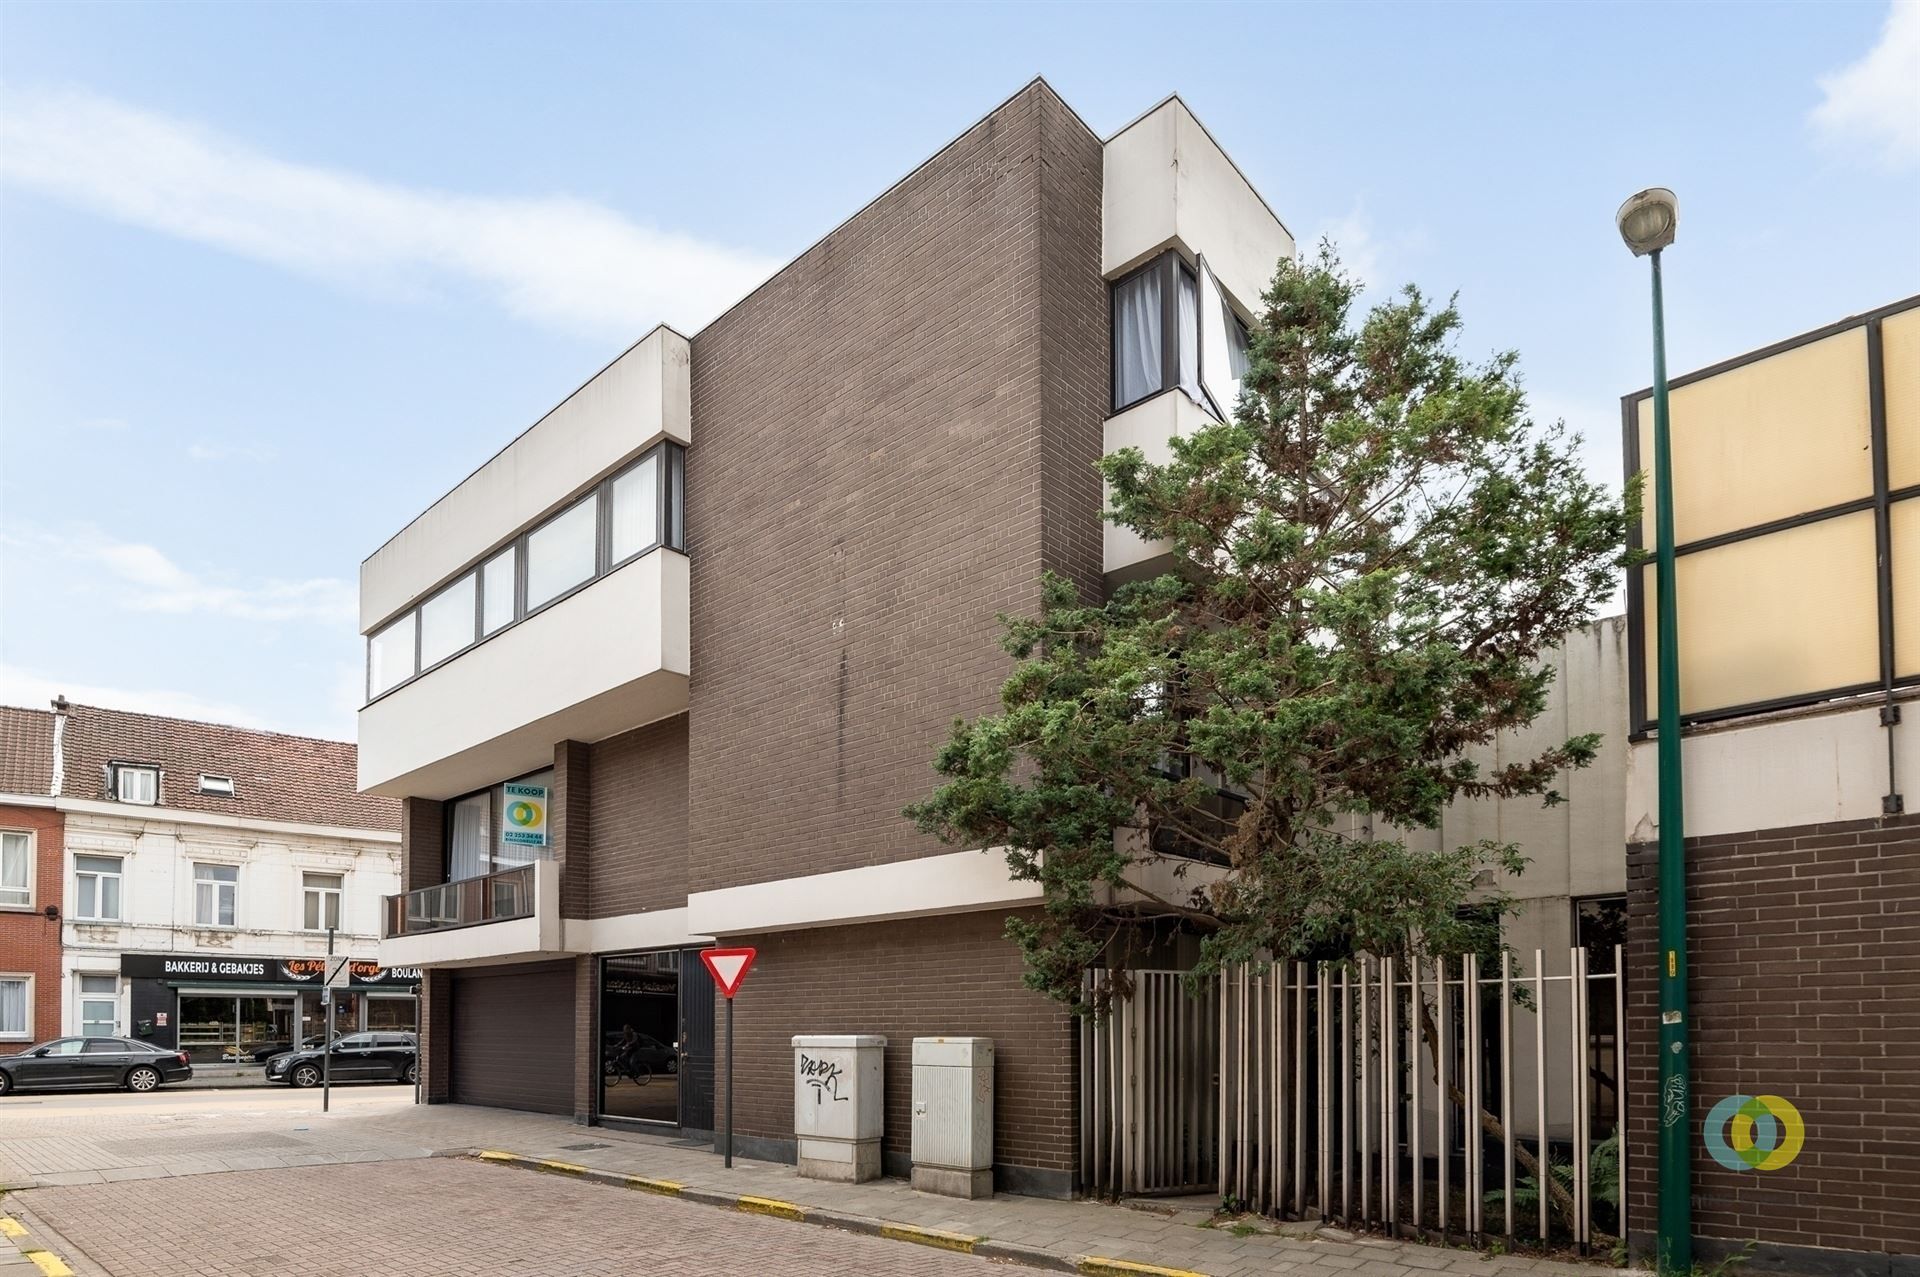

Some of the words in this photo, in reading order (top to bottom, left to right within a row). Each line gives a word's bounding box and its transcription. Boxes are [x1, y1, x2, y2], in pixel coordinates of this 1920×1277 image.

[518, 788, 544, 796] KOOP
[165, 960, 209, 973] BAKKERIJ
[210, 963, 218, 974] &
[219, 962, 264, 976] GEBAKJES
[288, 960, 305, 974] Les
